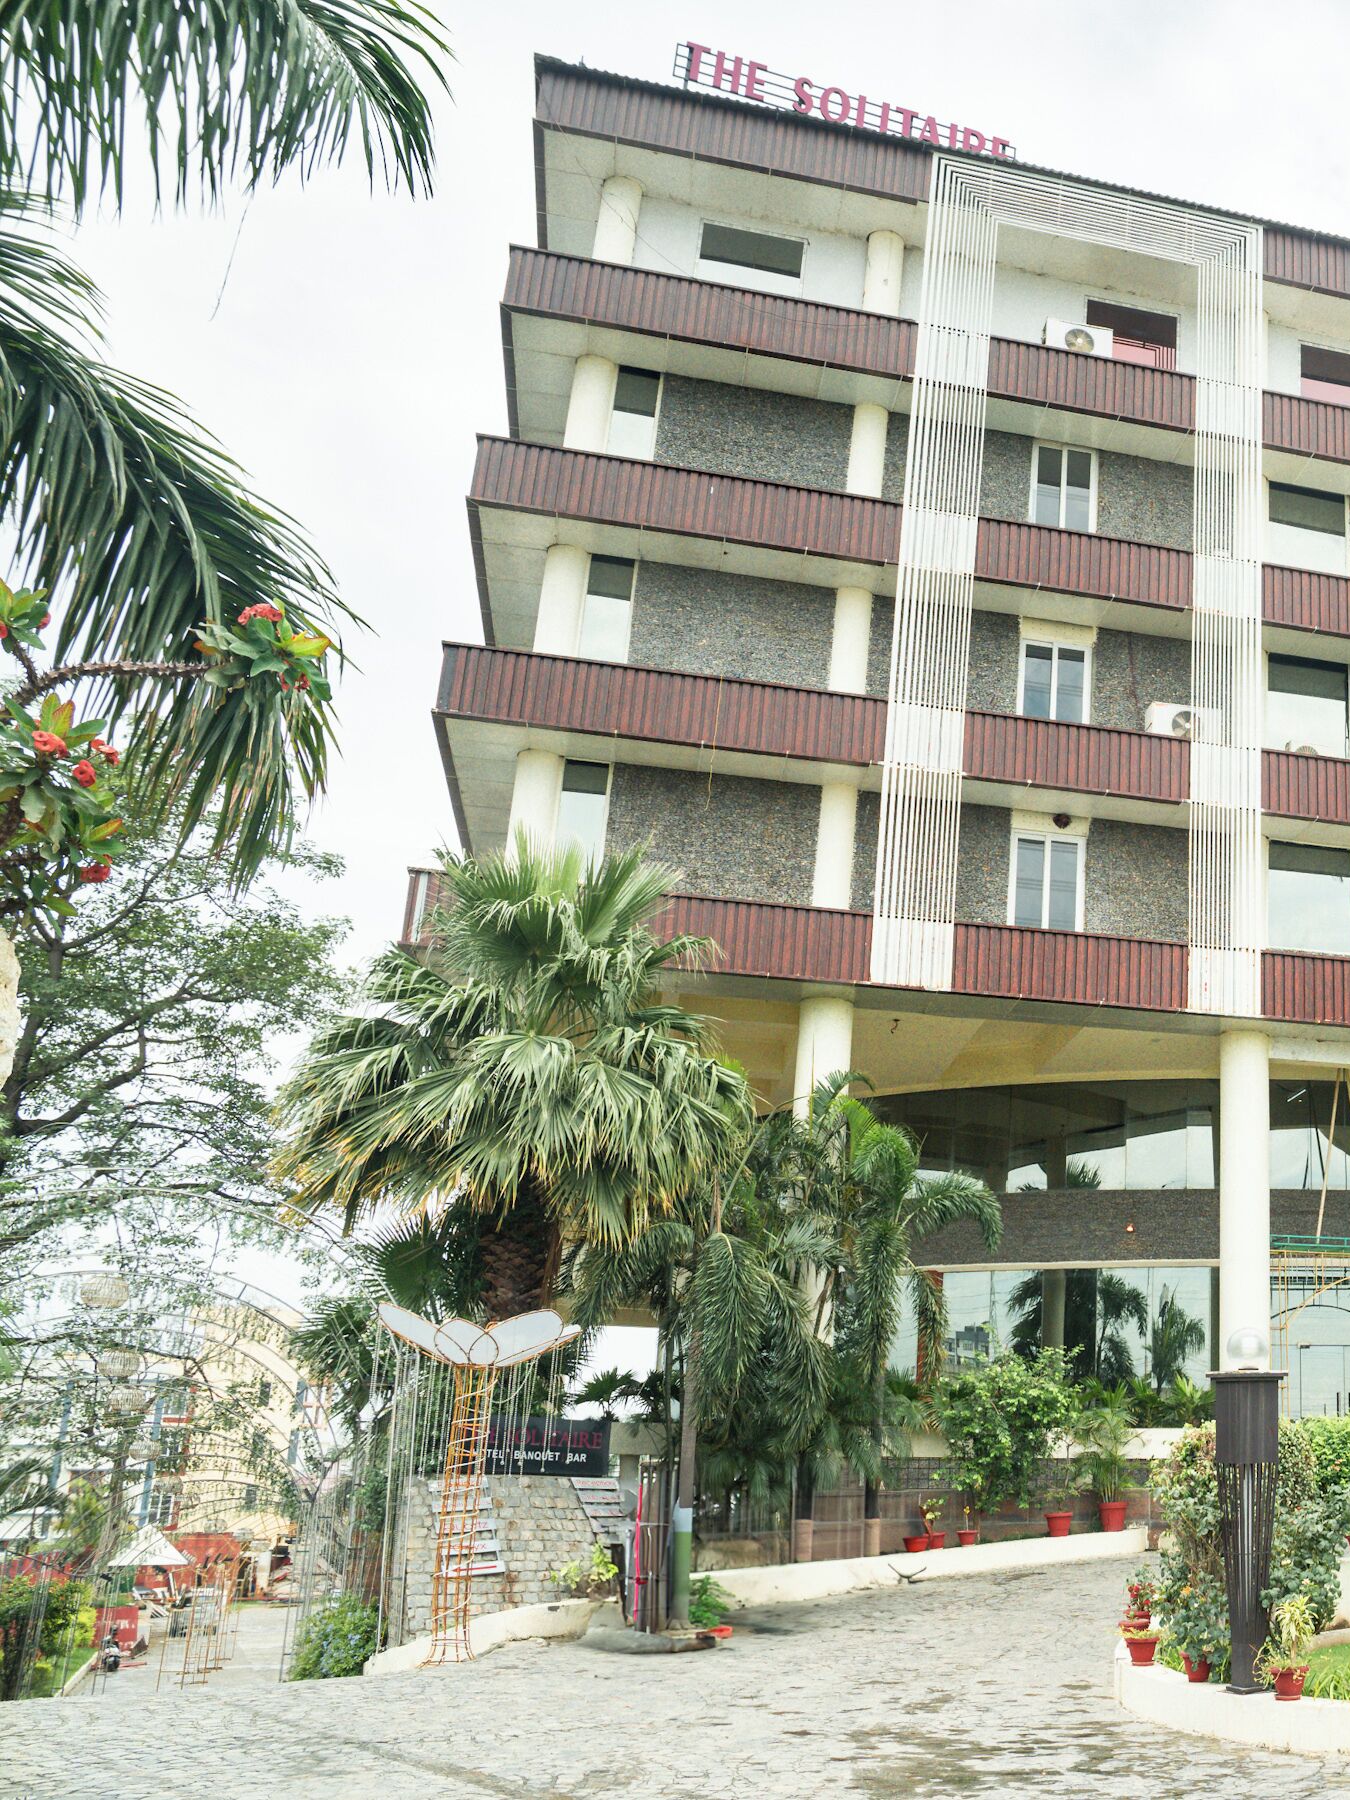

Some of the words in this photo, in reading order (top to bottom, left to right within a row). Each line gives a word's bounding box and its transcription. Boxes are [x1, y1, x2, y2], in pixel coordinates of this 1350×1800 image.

[687, 41, 767, 102] THE
[793, 77, 1010, 158] SOLITAIRE
[506, 1425, 602, 1448] OLITAIRE
[514, 1450, 560, 1461] BANQUET
[567, 1453, 587, 1463] BAR
